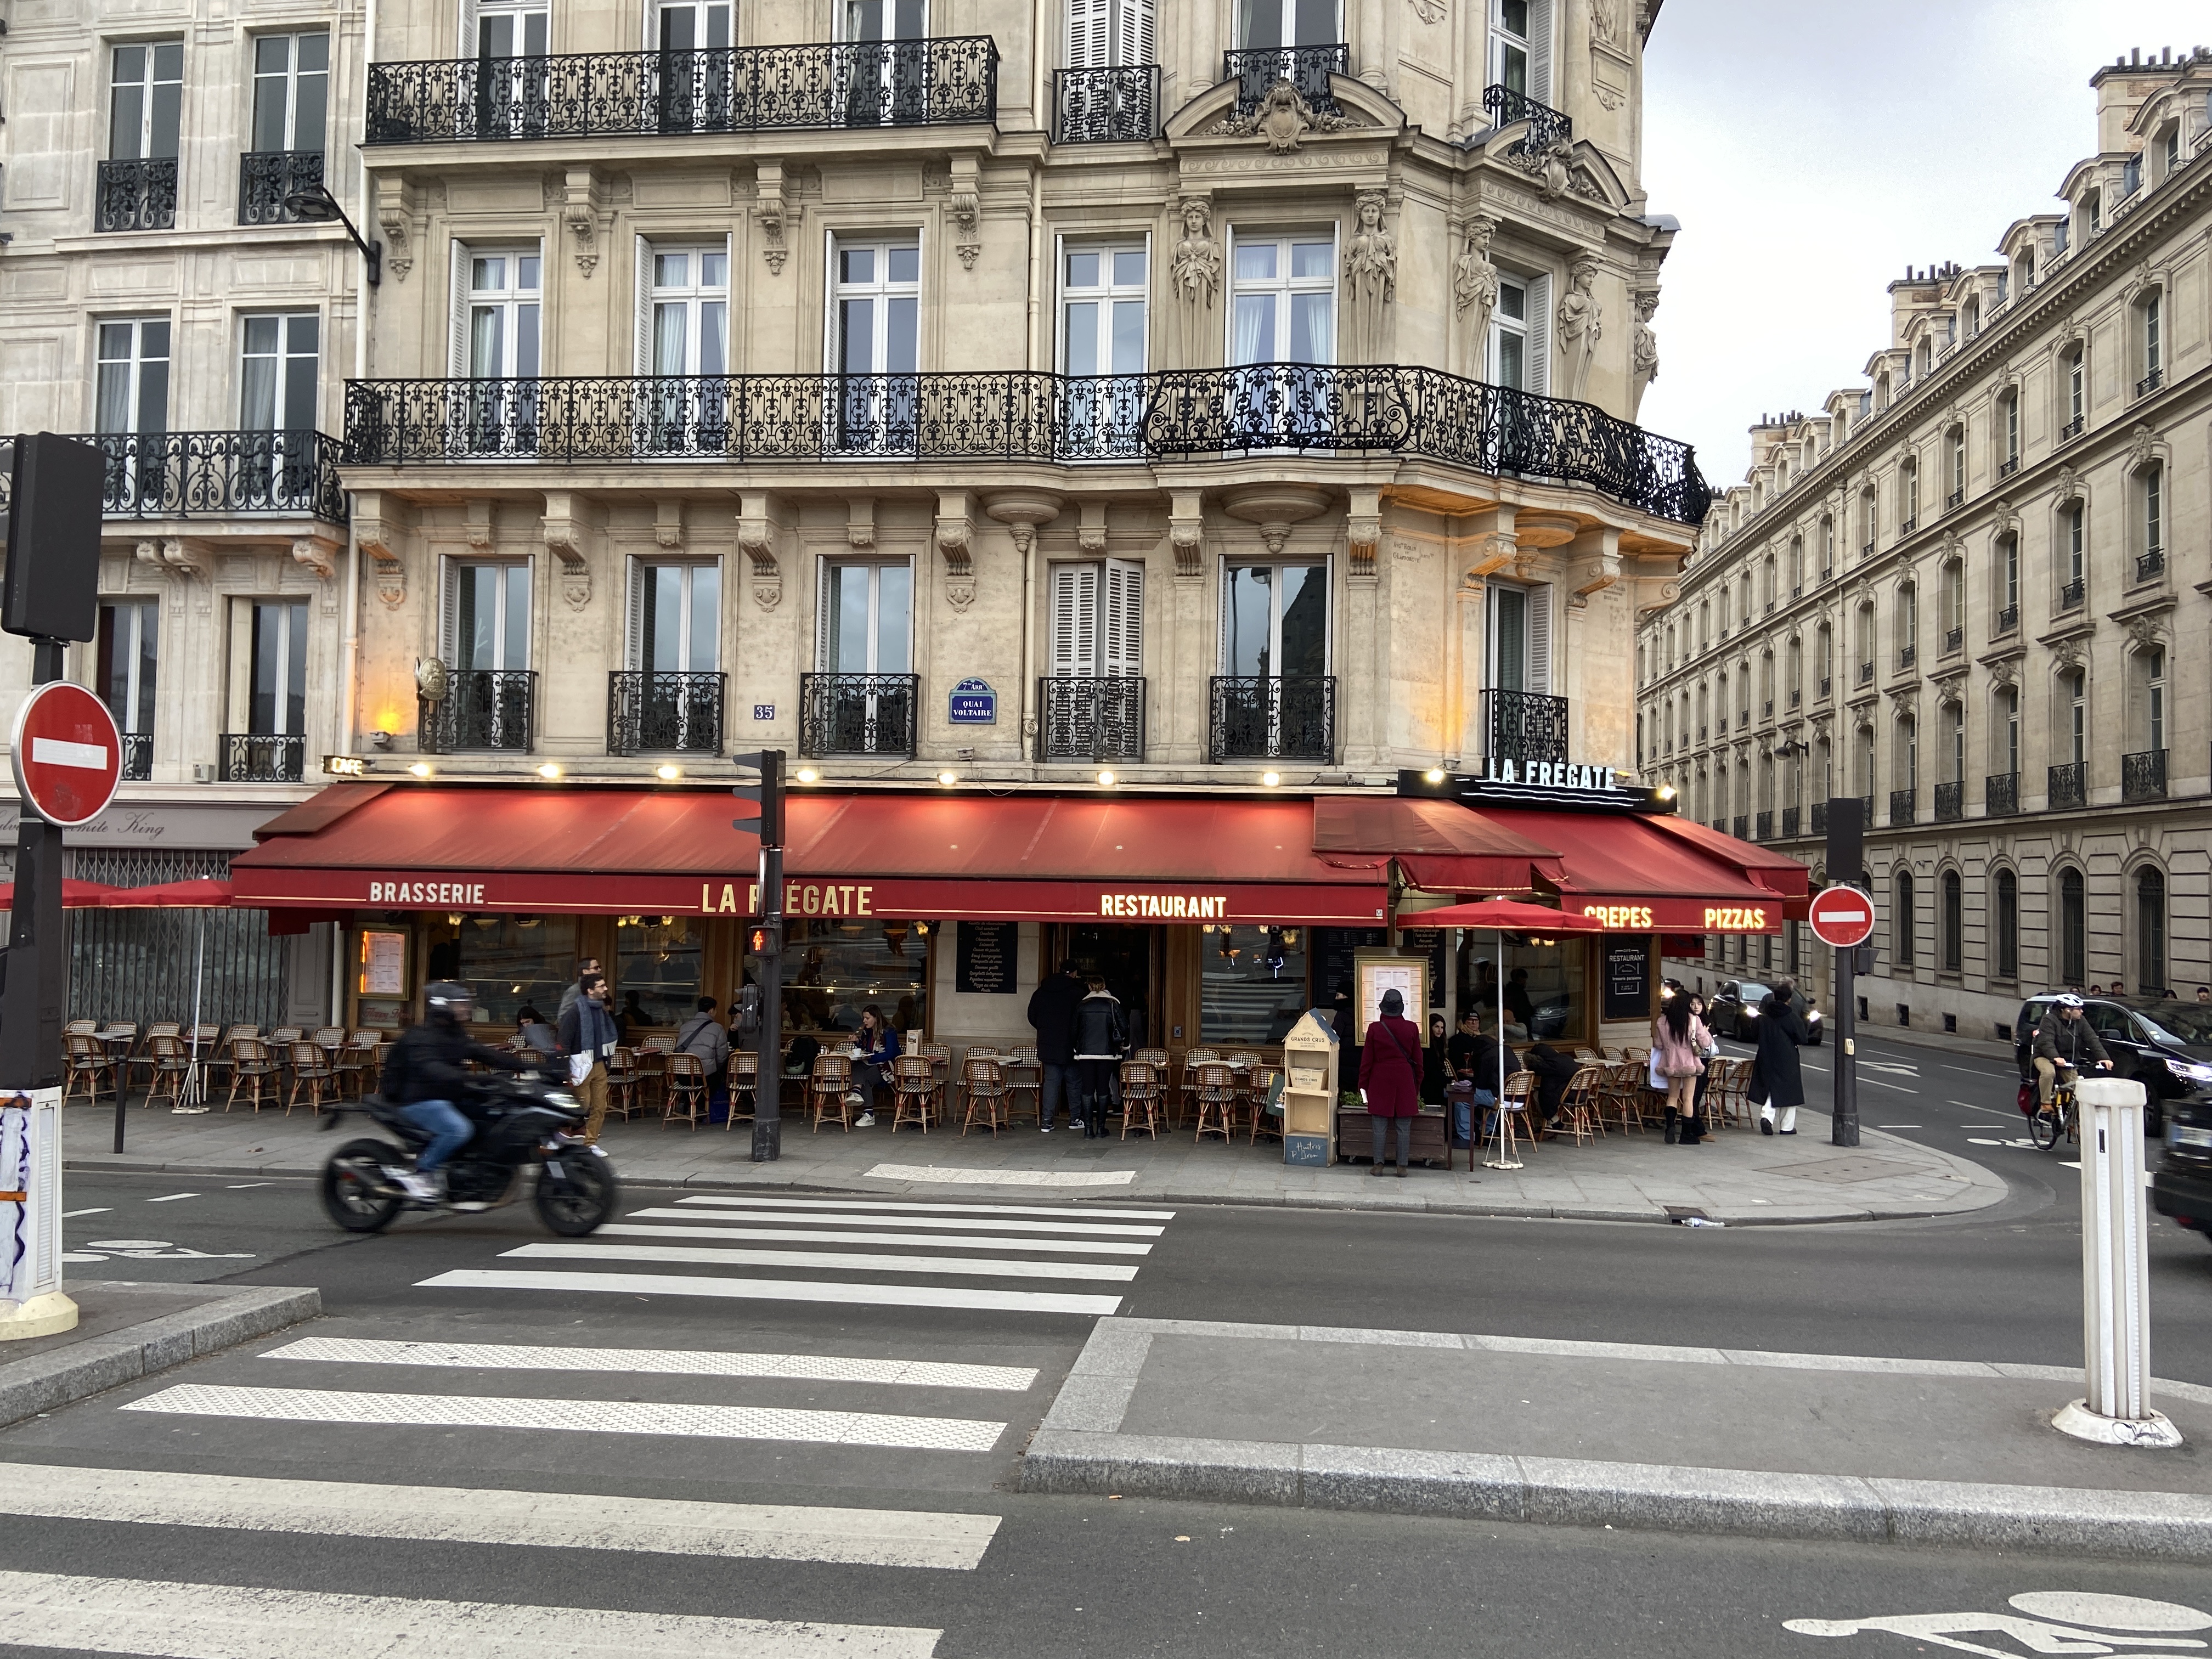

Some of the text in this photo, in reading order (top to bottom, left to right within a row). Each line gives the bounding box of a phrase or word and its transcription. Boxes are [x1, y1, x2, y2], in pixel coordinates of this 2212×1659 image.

[756, 706, 773, 719] 35
[1489, 757, 1616, 791] LA FRÉGATE
[117, 811, 165, 841] King
[370, 882, 485, 904] BRASSERIE
[702, 879, 873, 916] LA FÉGATE
[1101, 894, 1227, 918] RESTAURANT
[1705, 907, 1766, 929] PIZZAS
